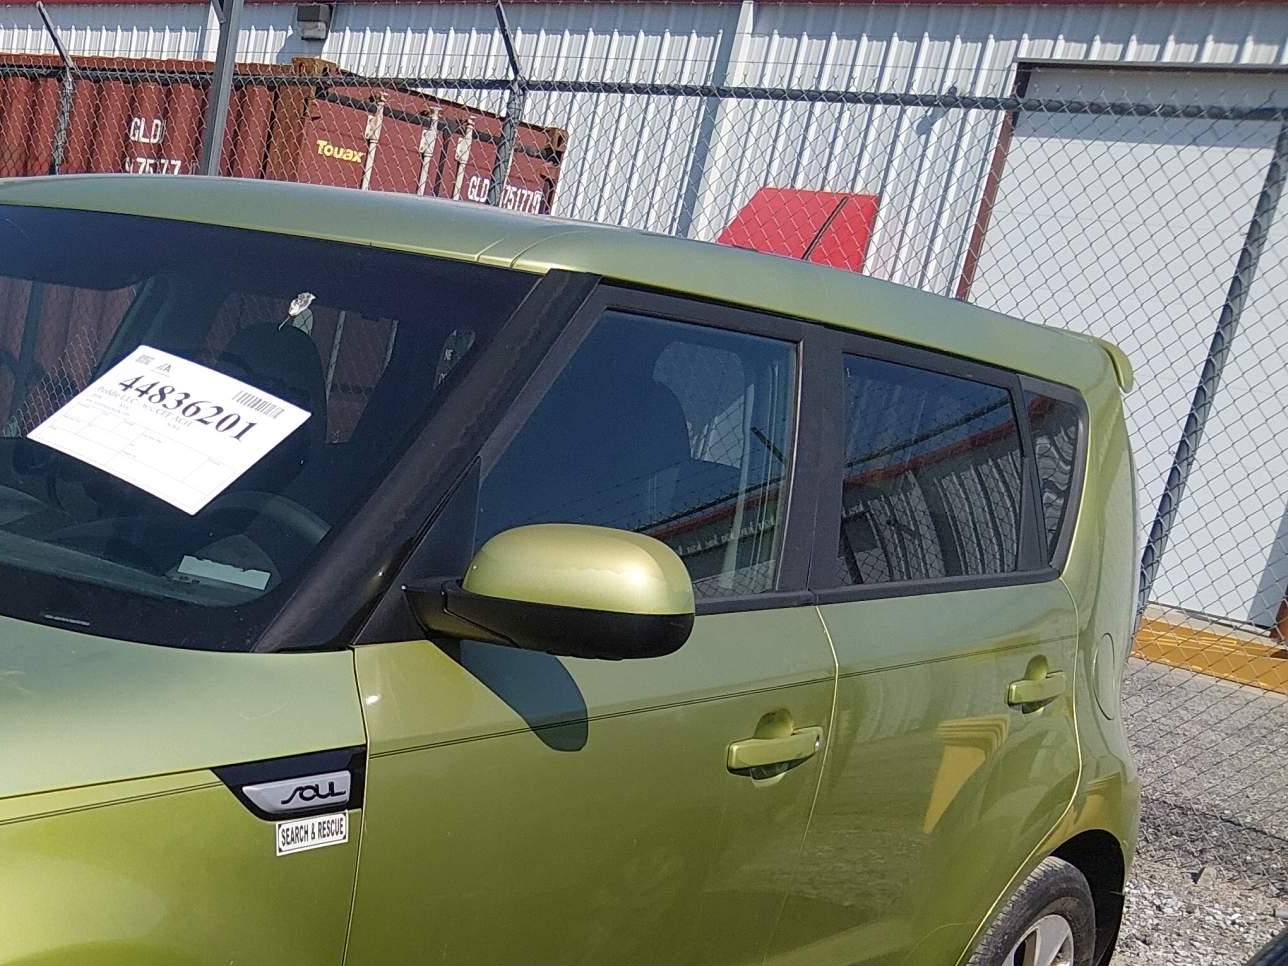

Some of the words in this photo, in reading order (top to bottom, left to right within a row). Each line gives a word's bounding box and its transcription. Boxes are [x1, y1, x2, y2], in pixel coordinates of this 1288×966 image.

[118, 374, 259, 442] 44836201
[281, 824, 309, 847] SEARCH
[311, 822, 316, 840] &
[317, 817, 344, 838] RESCUE
